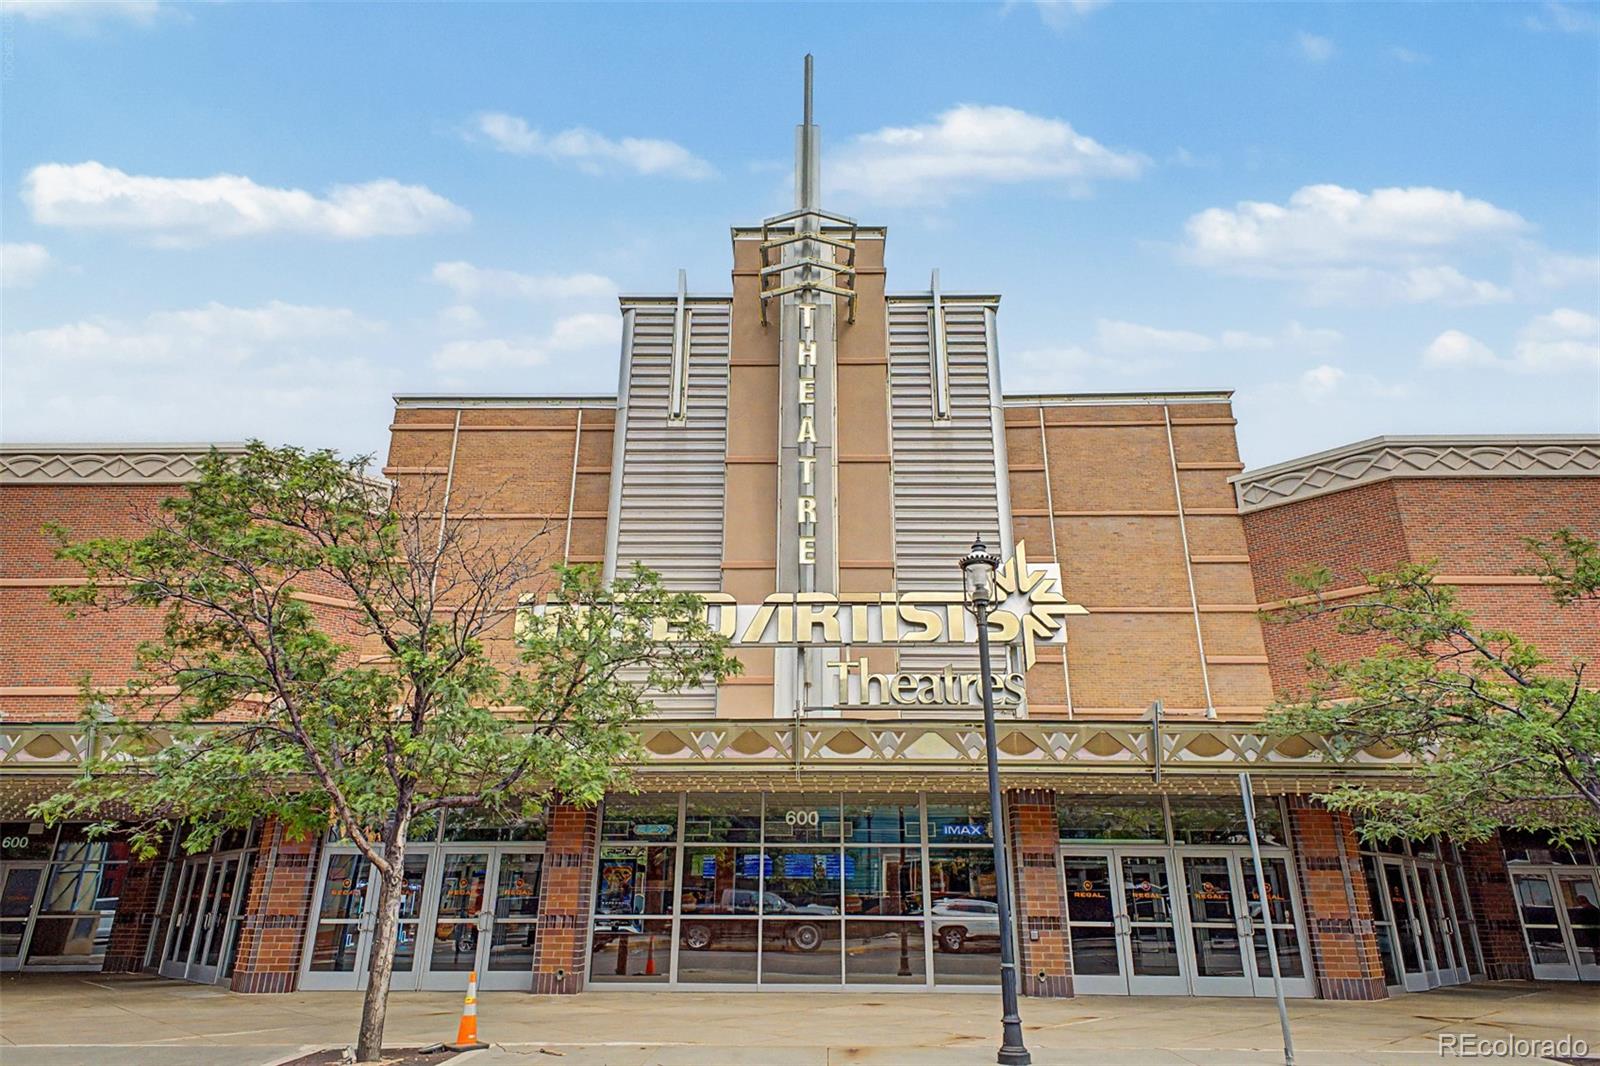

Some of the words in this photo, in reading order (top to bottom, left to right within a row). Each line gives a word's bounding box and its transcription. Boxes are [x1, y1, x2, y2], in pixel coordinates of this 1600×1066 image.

[797, 303, 817, 565] THEATRE
[827, 657, 1024, 705] Theatres
[785, 811, 818, 825] 600
[944, 825, 982, 834] IMAX
[2, 836, 28, 848] 600
